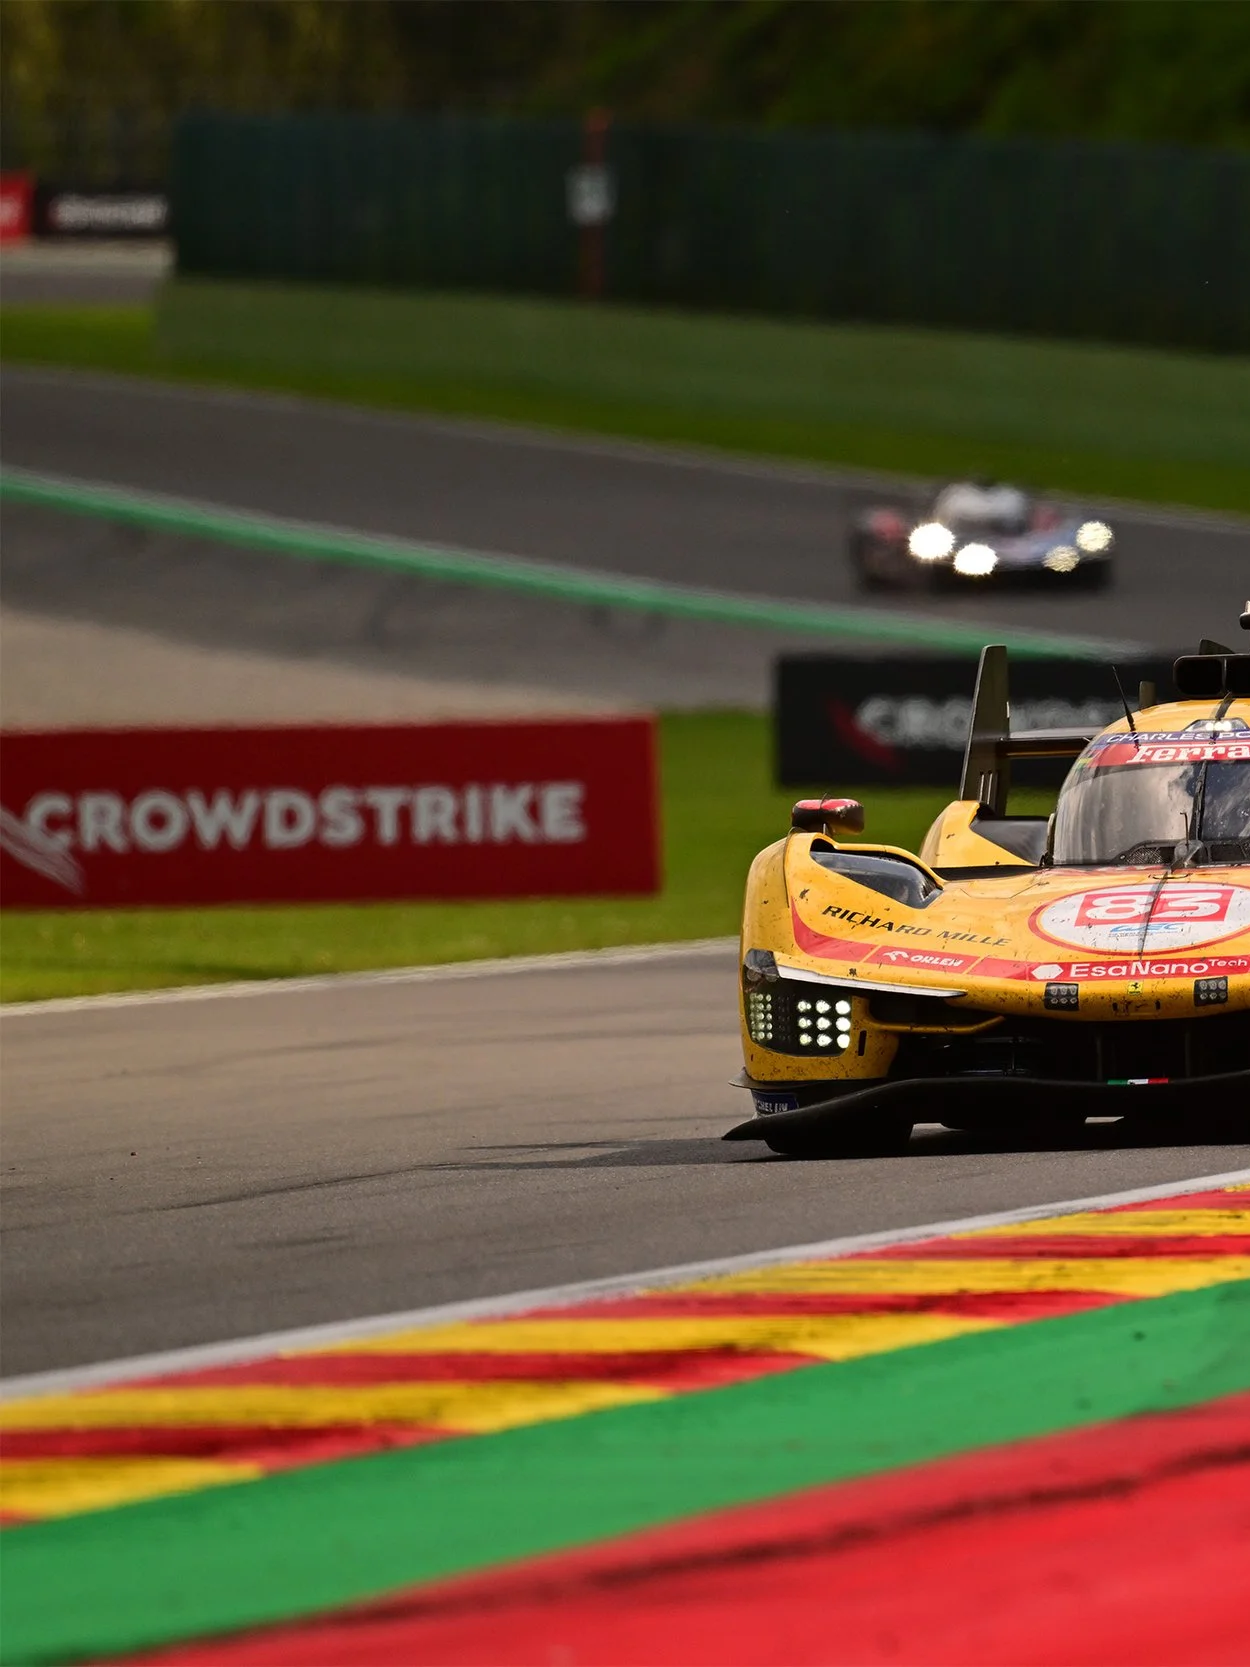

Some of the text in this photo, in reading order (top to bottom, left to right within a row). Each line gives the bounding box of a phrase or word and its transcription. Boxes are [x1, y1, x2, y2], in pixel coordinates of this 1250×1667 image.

[1107, 731, 1210, 743] CHARLES
[27, 781, 587, 853] CROWDSTRIKE
[1085, 892, 1224, 920] 83
[822, 905, 1012, 947] RICHARD MILLE
[910, 954, 965, 967] ORLEN
